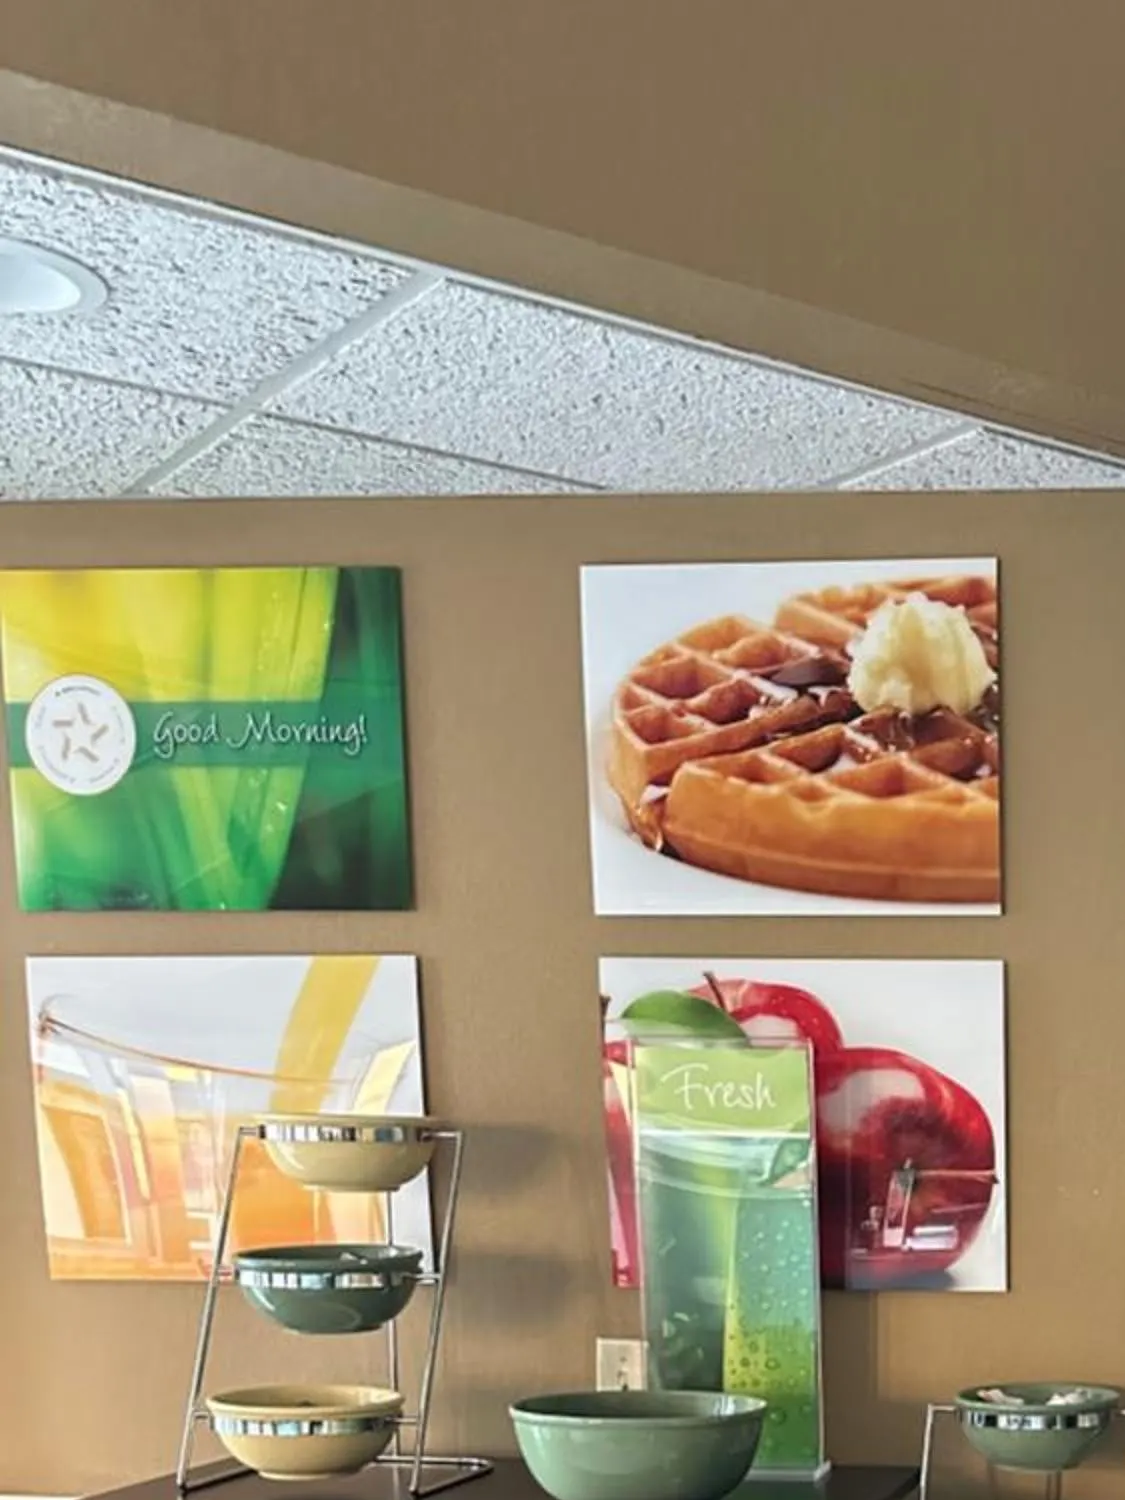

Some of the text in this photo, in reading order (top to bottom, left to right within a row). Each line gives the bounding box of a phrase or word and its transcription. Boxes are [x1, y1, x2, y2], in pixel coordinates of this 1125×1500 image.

[153, 711, 219, 759] Good
[226, 711, 367, 756] Morning!
[660, 1062, 777, 1111] Fresh
